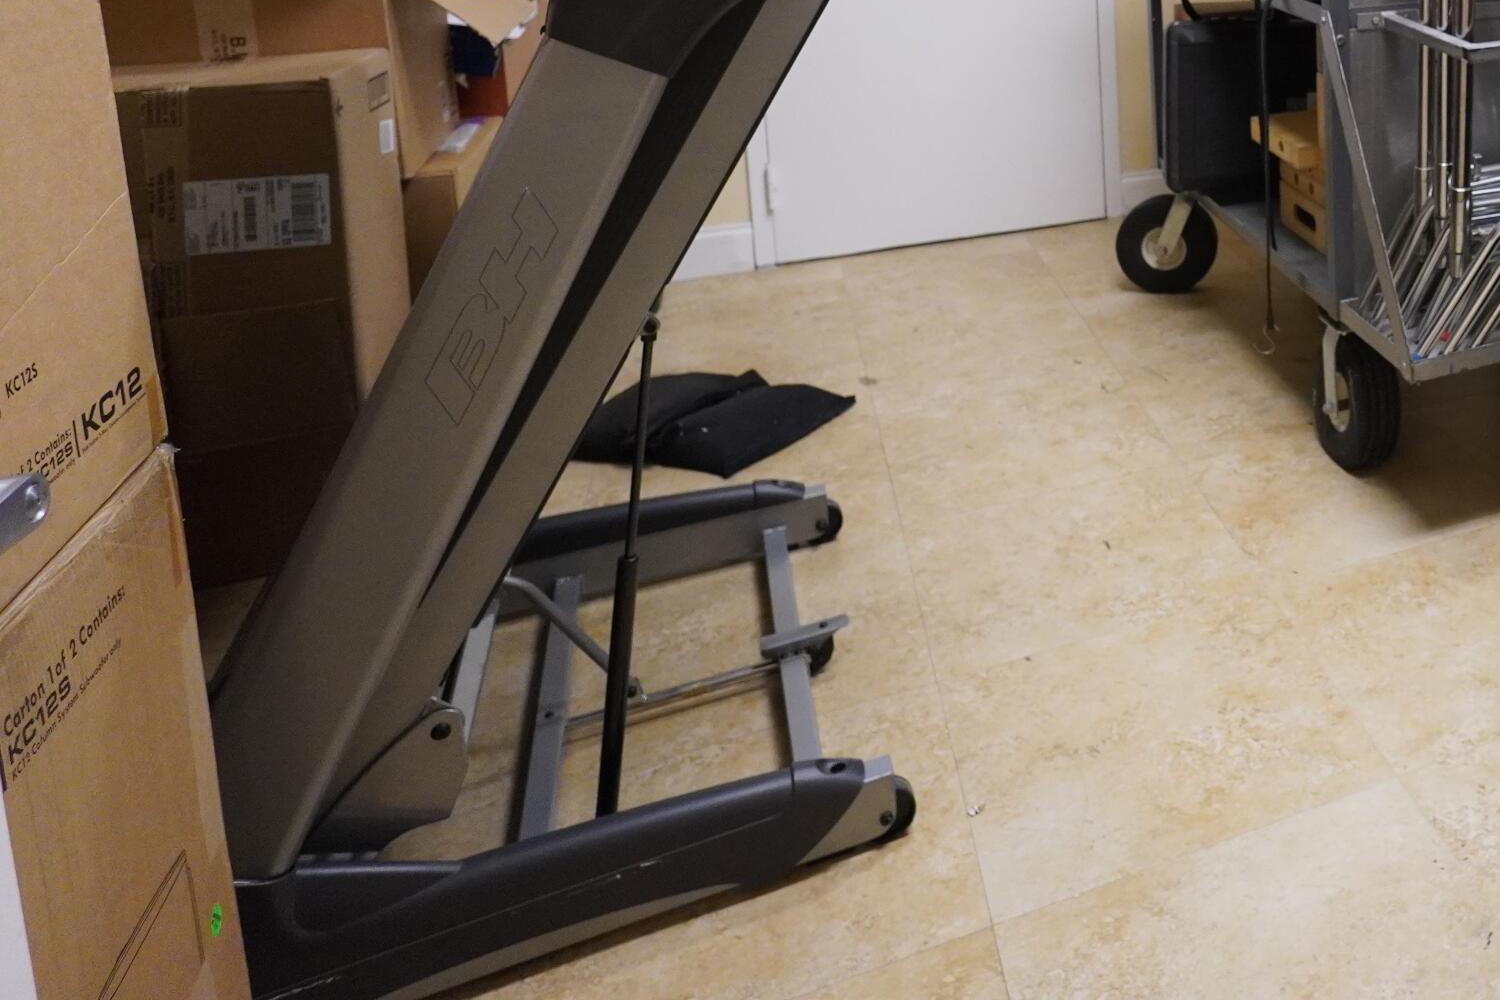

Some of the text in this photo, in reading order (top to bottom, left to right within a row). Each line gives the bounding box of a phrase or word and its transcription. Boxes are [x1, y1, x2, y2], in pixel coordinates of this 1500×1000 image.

[5, 362, 39, 399] KC12S
[81, 366, 143, 441] KC12
[27, 458, 34, 474] 2
[34, 428, 72, 465] Contains:
[37, 441, 73, 478] C12S
[4, 682, 46, 737] Carton
[69, 638, 78, 661] 2
[79, 585, 126, 646] Contains:
[7, 675, 72, 765] KC12S
